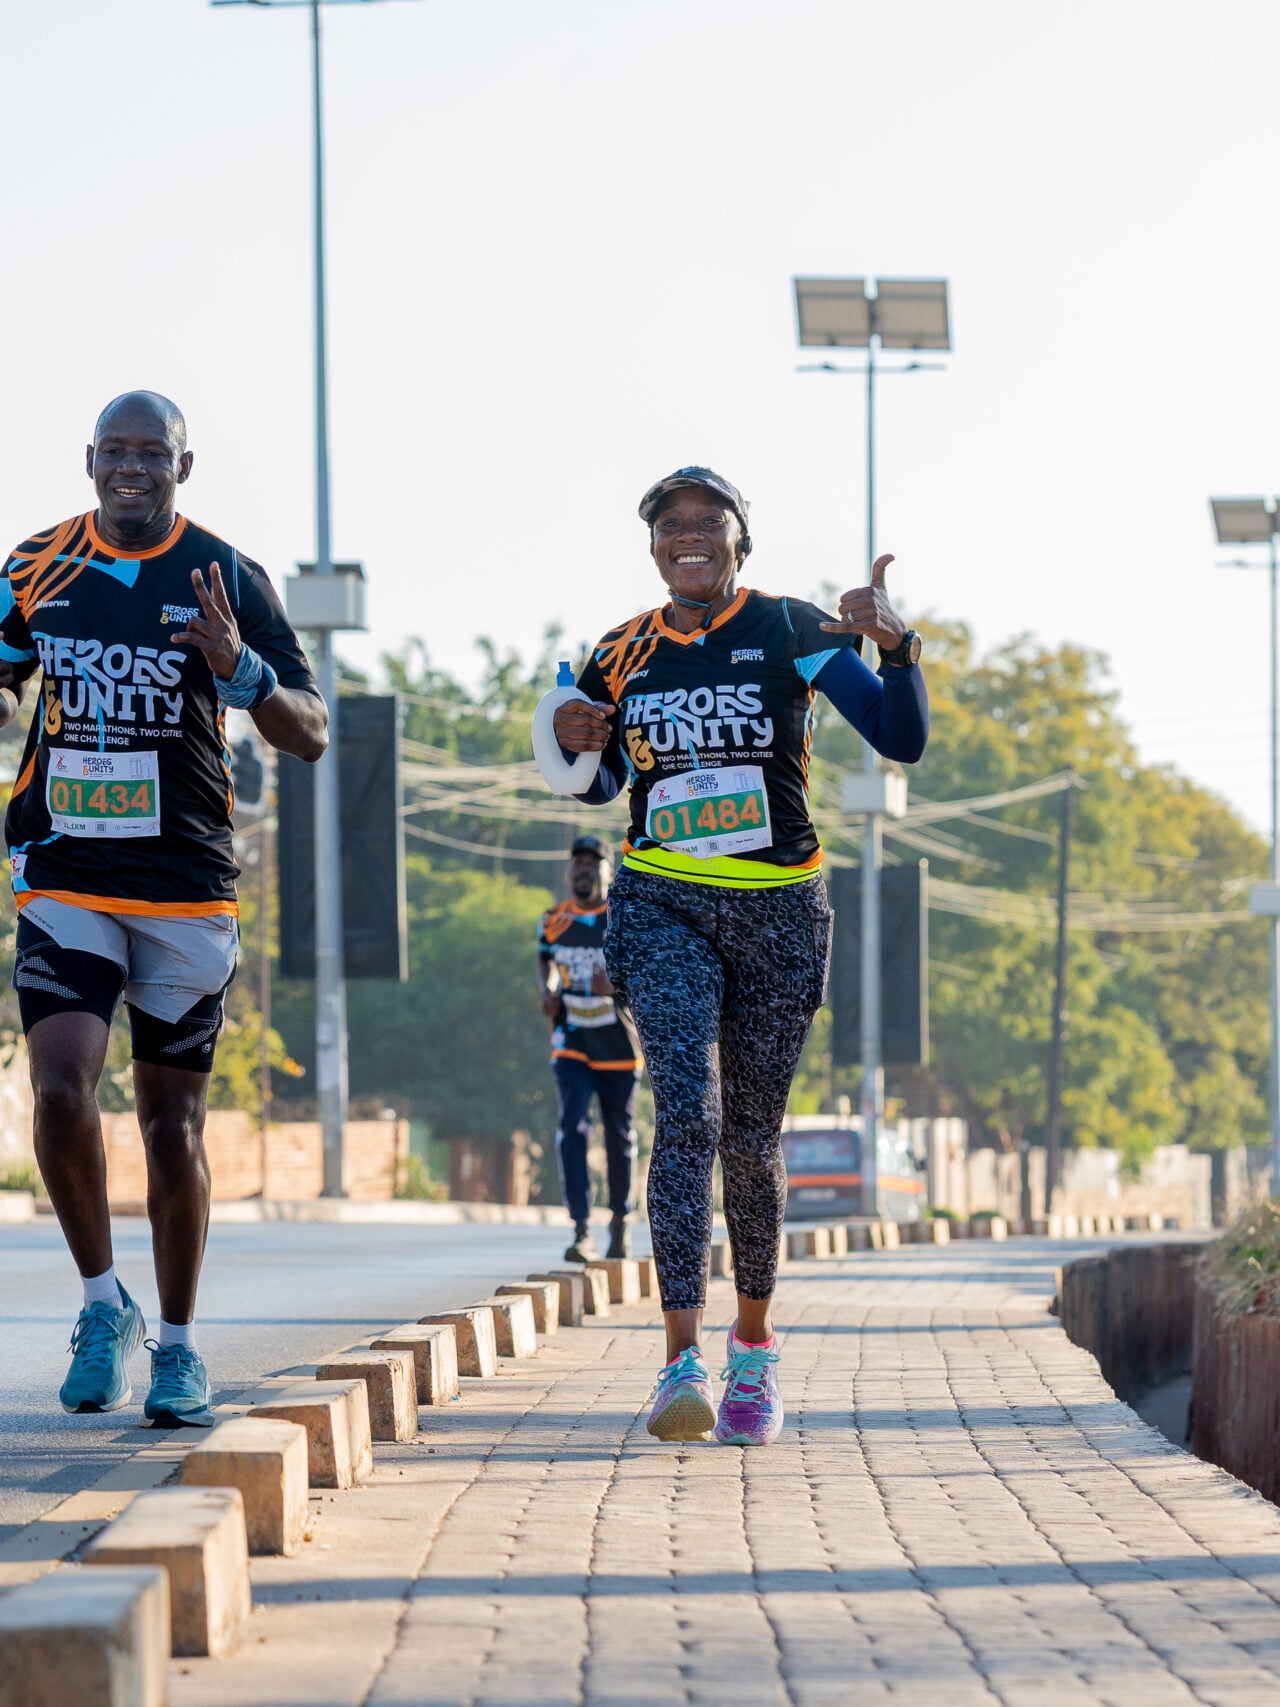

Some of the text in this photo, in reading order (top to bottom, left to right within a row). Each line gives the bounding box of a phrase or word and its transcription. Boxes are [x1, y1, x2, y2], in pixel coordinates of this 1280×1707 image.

[162, 604, 200, 617] HEROES
[169, 613, 193, 624] UNIT
[37, 636, 188, 687] HEROES
[61, 680, 184, 725] UNITY
[624, 683, 763, 725] HEROES
[63, 721, 81, 731] TWO
[82, 724, 138, 736] MARATHONS,
[139, 728, 160, 737] TWO
[648, 717, 774, 752] UNITY
[63, 733, 130, 746] ONE CHALLENGE
[82, 756, 112, 766] HEROES
[657, 755, 676, 763] TWO
[676, 752, 729, 761] MARATHONS,
[730, 751, 750, 759] TWO
[88, 765, 114, 773] UNITY
[676, 760, 722, 769] CHALLENGE
[686, 774, 716, 786] HEROES
[693, 781, 719, 791] UNITY
[52, 781, 151, 814] 01434
[654, 794, 761, 840] 01484
